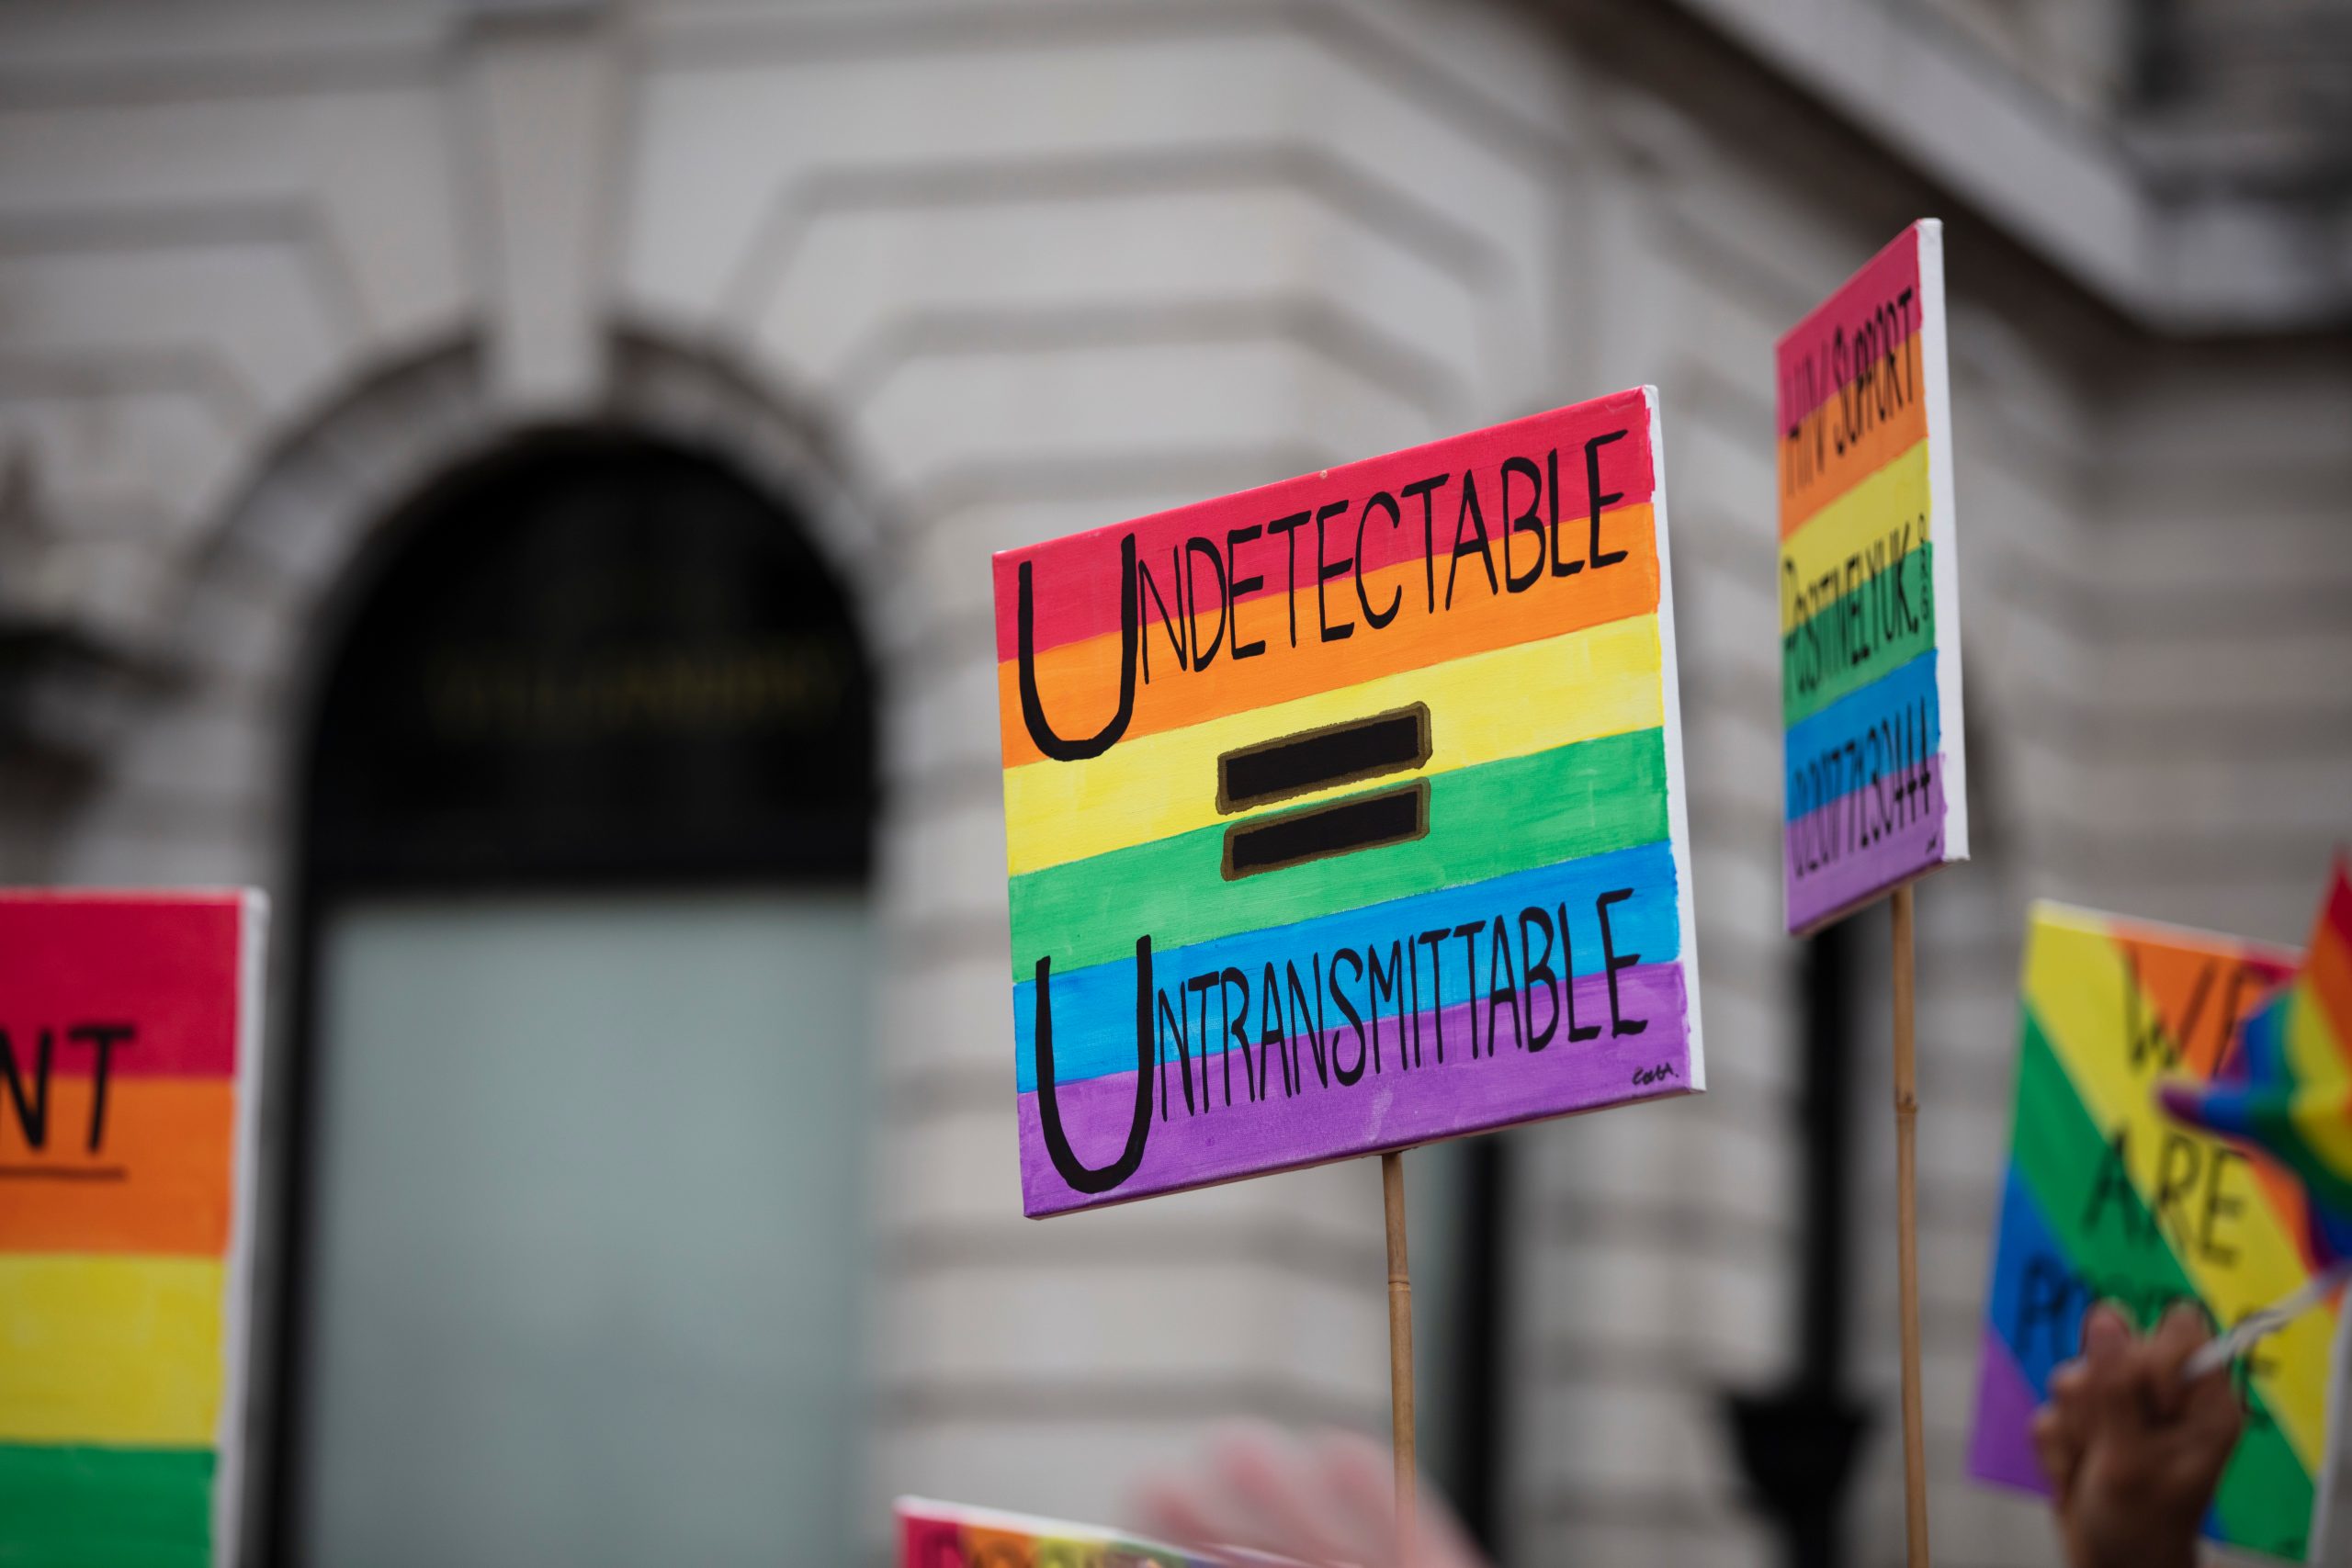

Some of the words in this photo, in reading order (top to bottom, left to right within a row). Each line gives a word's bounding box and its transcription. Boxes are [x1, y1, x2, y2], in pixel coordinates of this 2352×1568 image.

[1782, 339, 1829, 497] HIV
[1018, 429, 1628, 761] UNDETECTABLE
[1035, 887, 1648, 1194] UNTRANSMITTABLE
[2081, 1120, 2251, 1269] ARE
